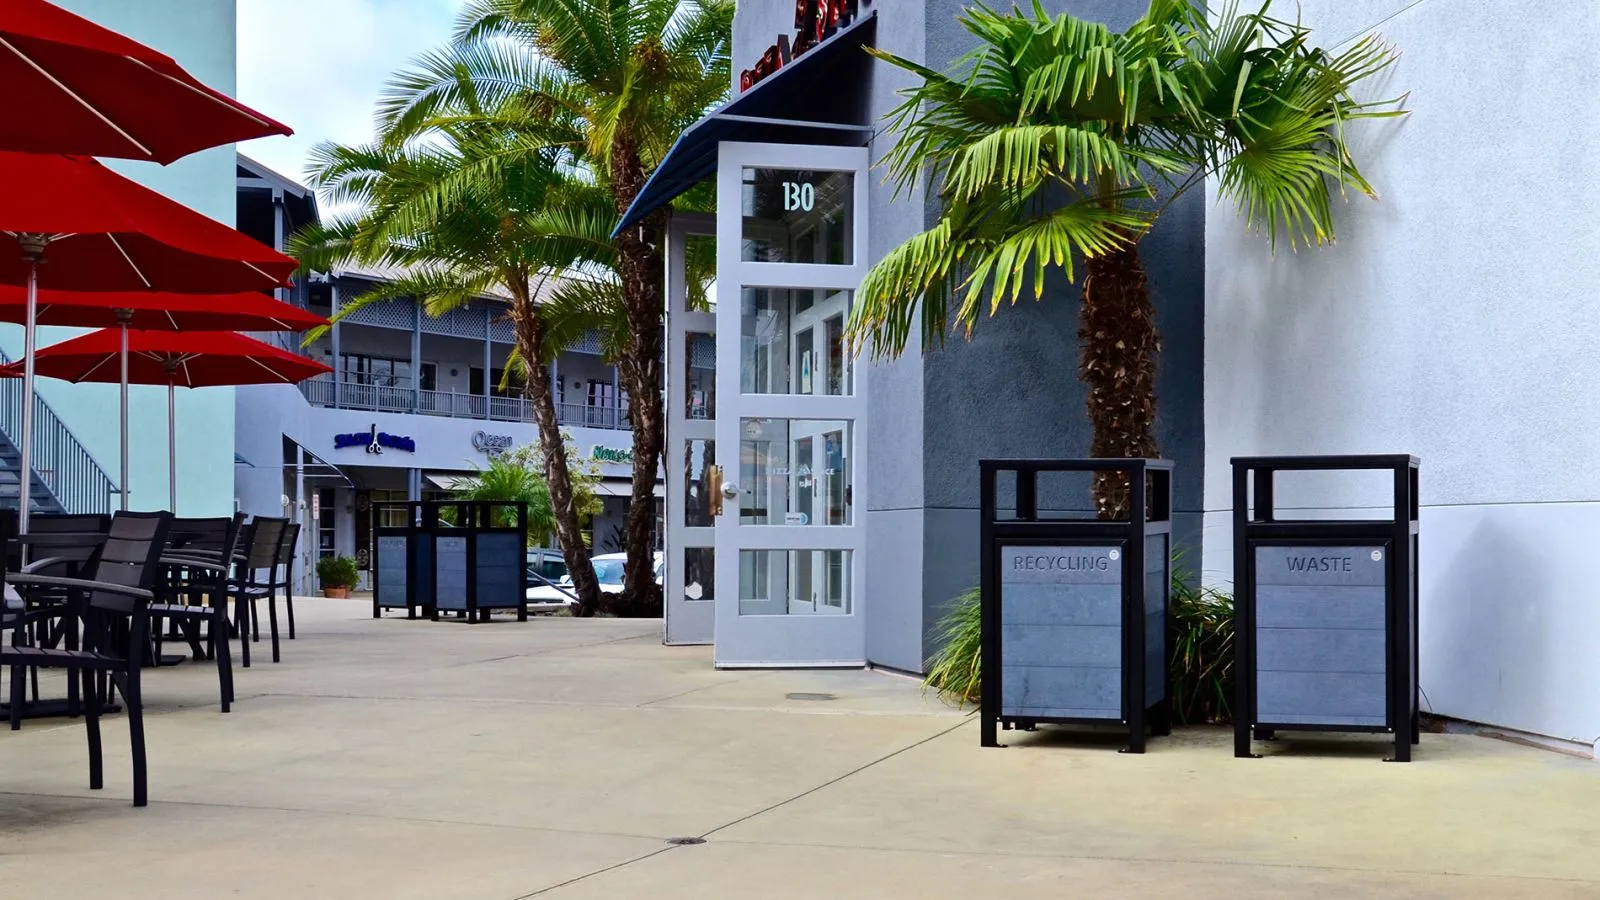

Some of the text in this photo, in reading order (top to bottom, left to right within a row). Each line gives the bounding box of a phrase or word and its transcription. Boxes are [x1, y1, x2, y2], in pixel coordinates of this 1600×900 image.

[782, 182, 815, 212] 130
[1013, 555, 1109, 571] RECYCLING
[1286, 556, 1353, 572] WASTE
